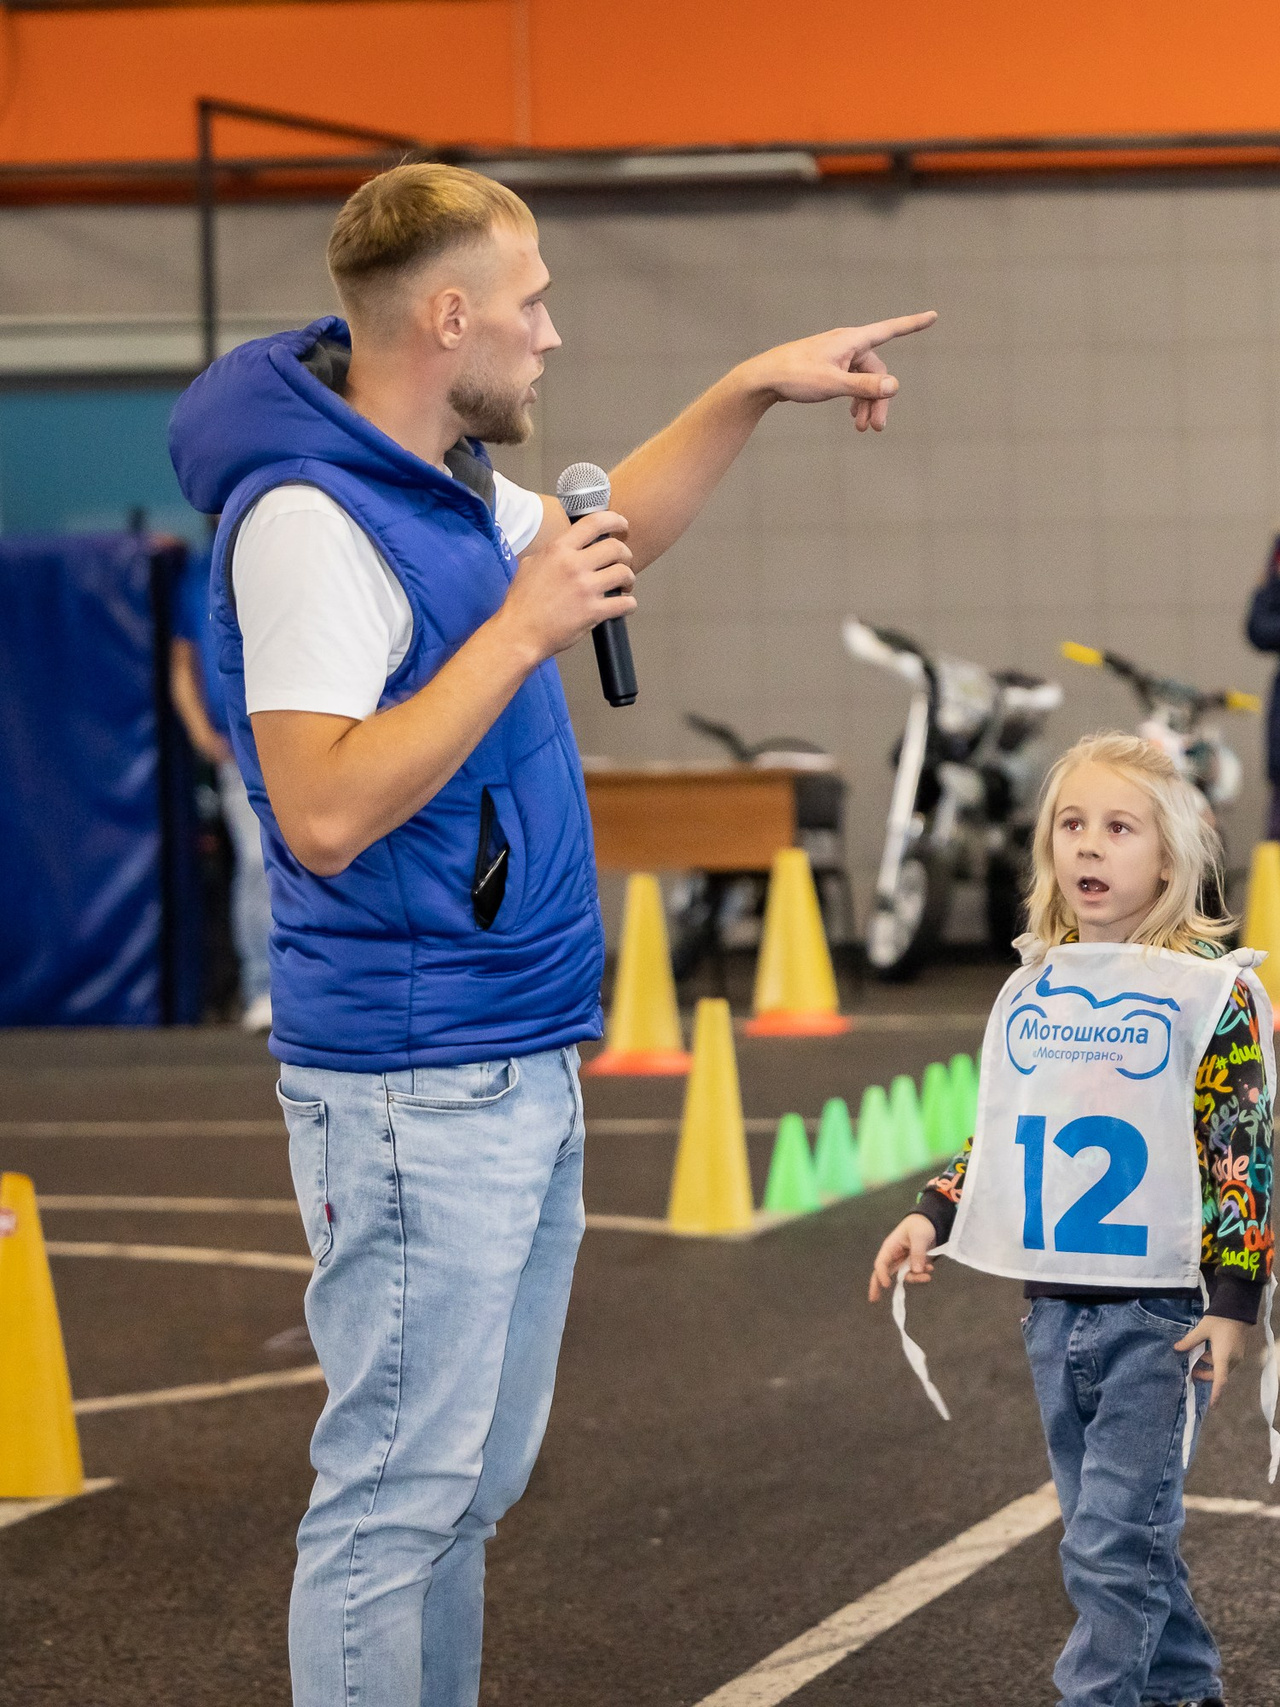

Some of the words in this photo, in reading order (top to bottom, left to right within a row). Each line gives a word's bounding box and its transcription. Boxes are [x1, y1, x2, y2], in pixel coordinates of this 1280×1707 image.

[1019, 1018, 1149, 1044] Мотошкола
[1032, 1046, 1123, 1063] «Мосгортранс»
[1015, 1114, 1149, 1257] 12
